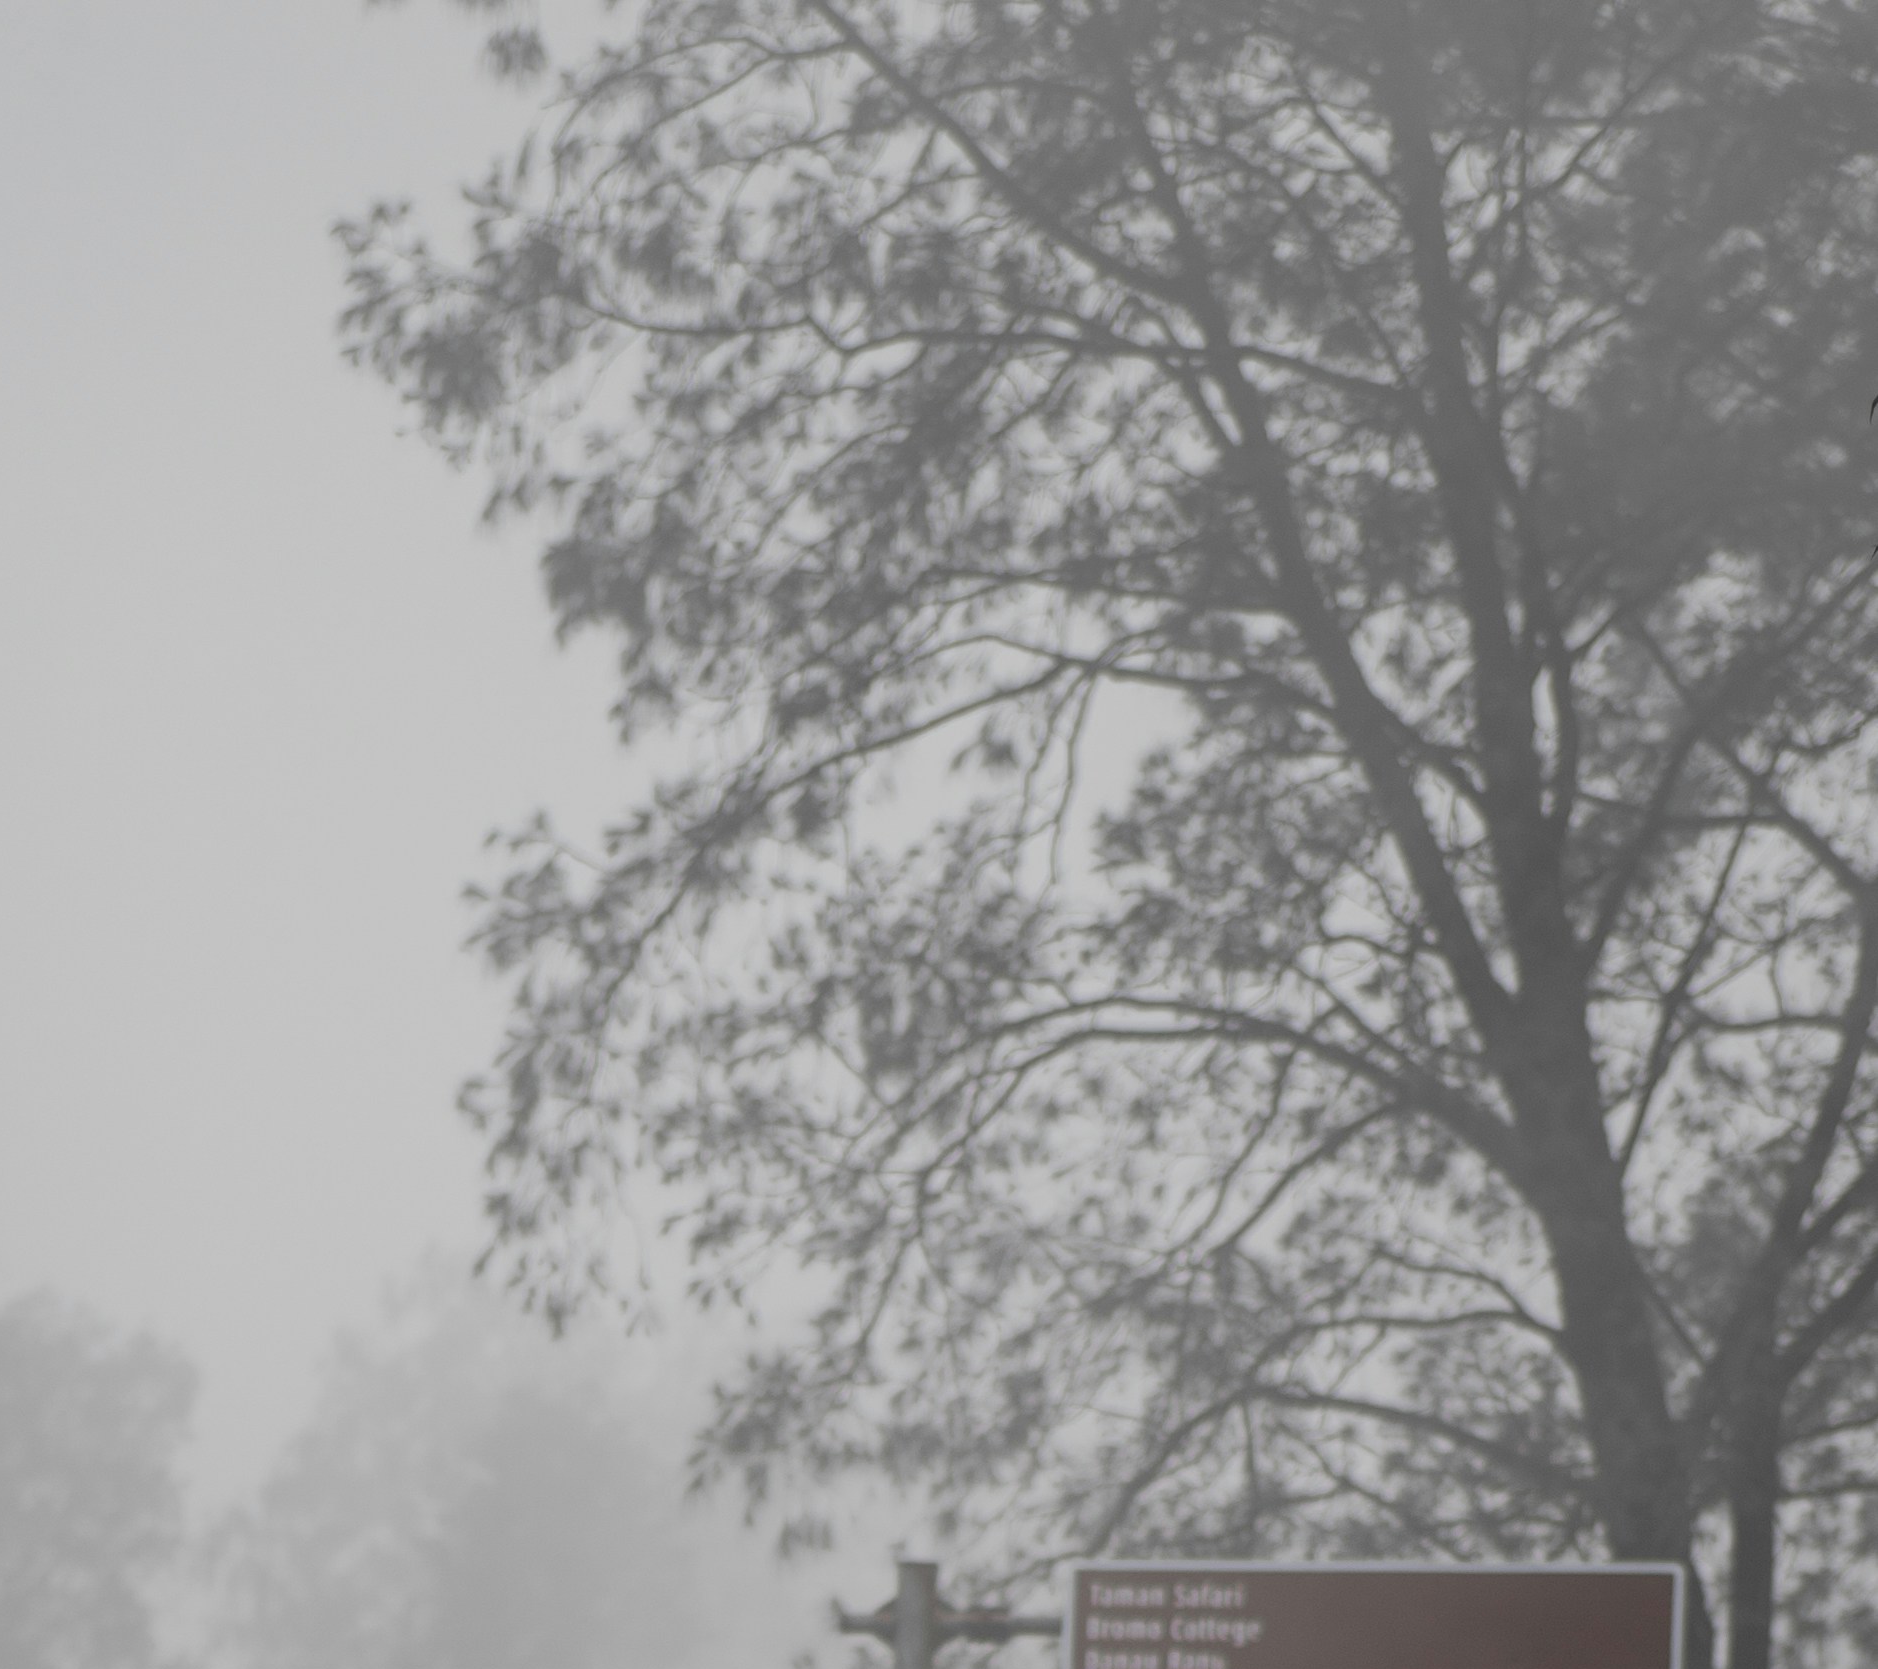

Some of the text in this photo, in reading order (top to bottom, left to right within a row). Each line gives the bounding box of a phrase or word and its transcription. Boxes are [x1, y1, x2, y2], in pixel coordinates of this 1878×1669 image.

[1090, 1582, 1244, 1607] Taman Safari
[1086, 1615, 1163, 1640] Bromo
